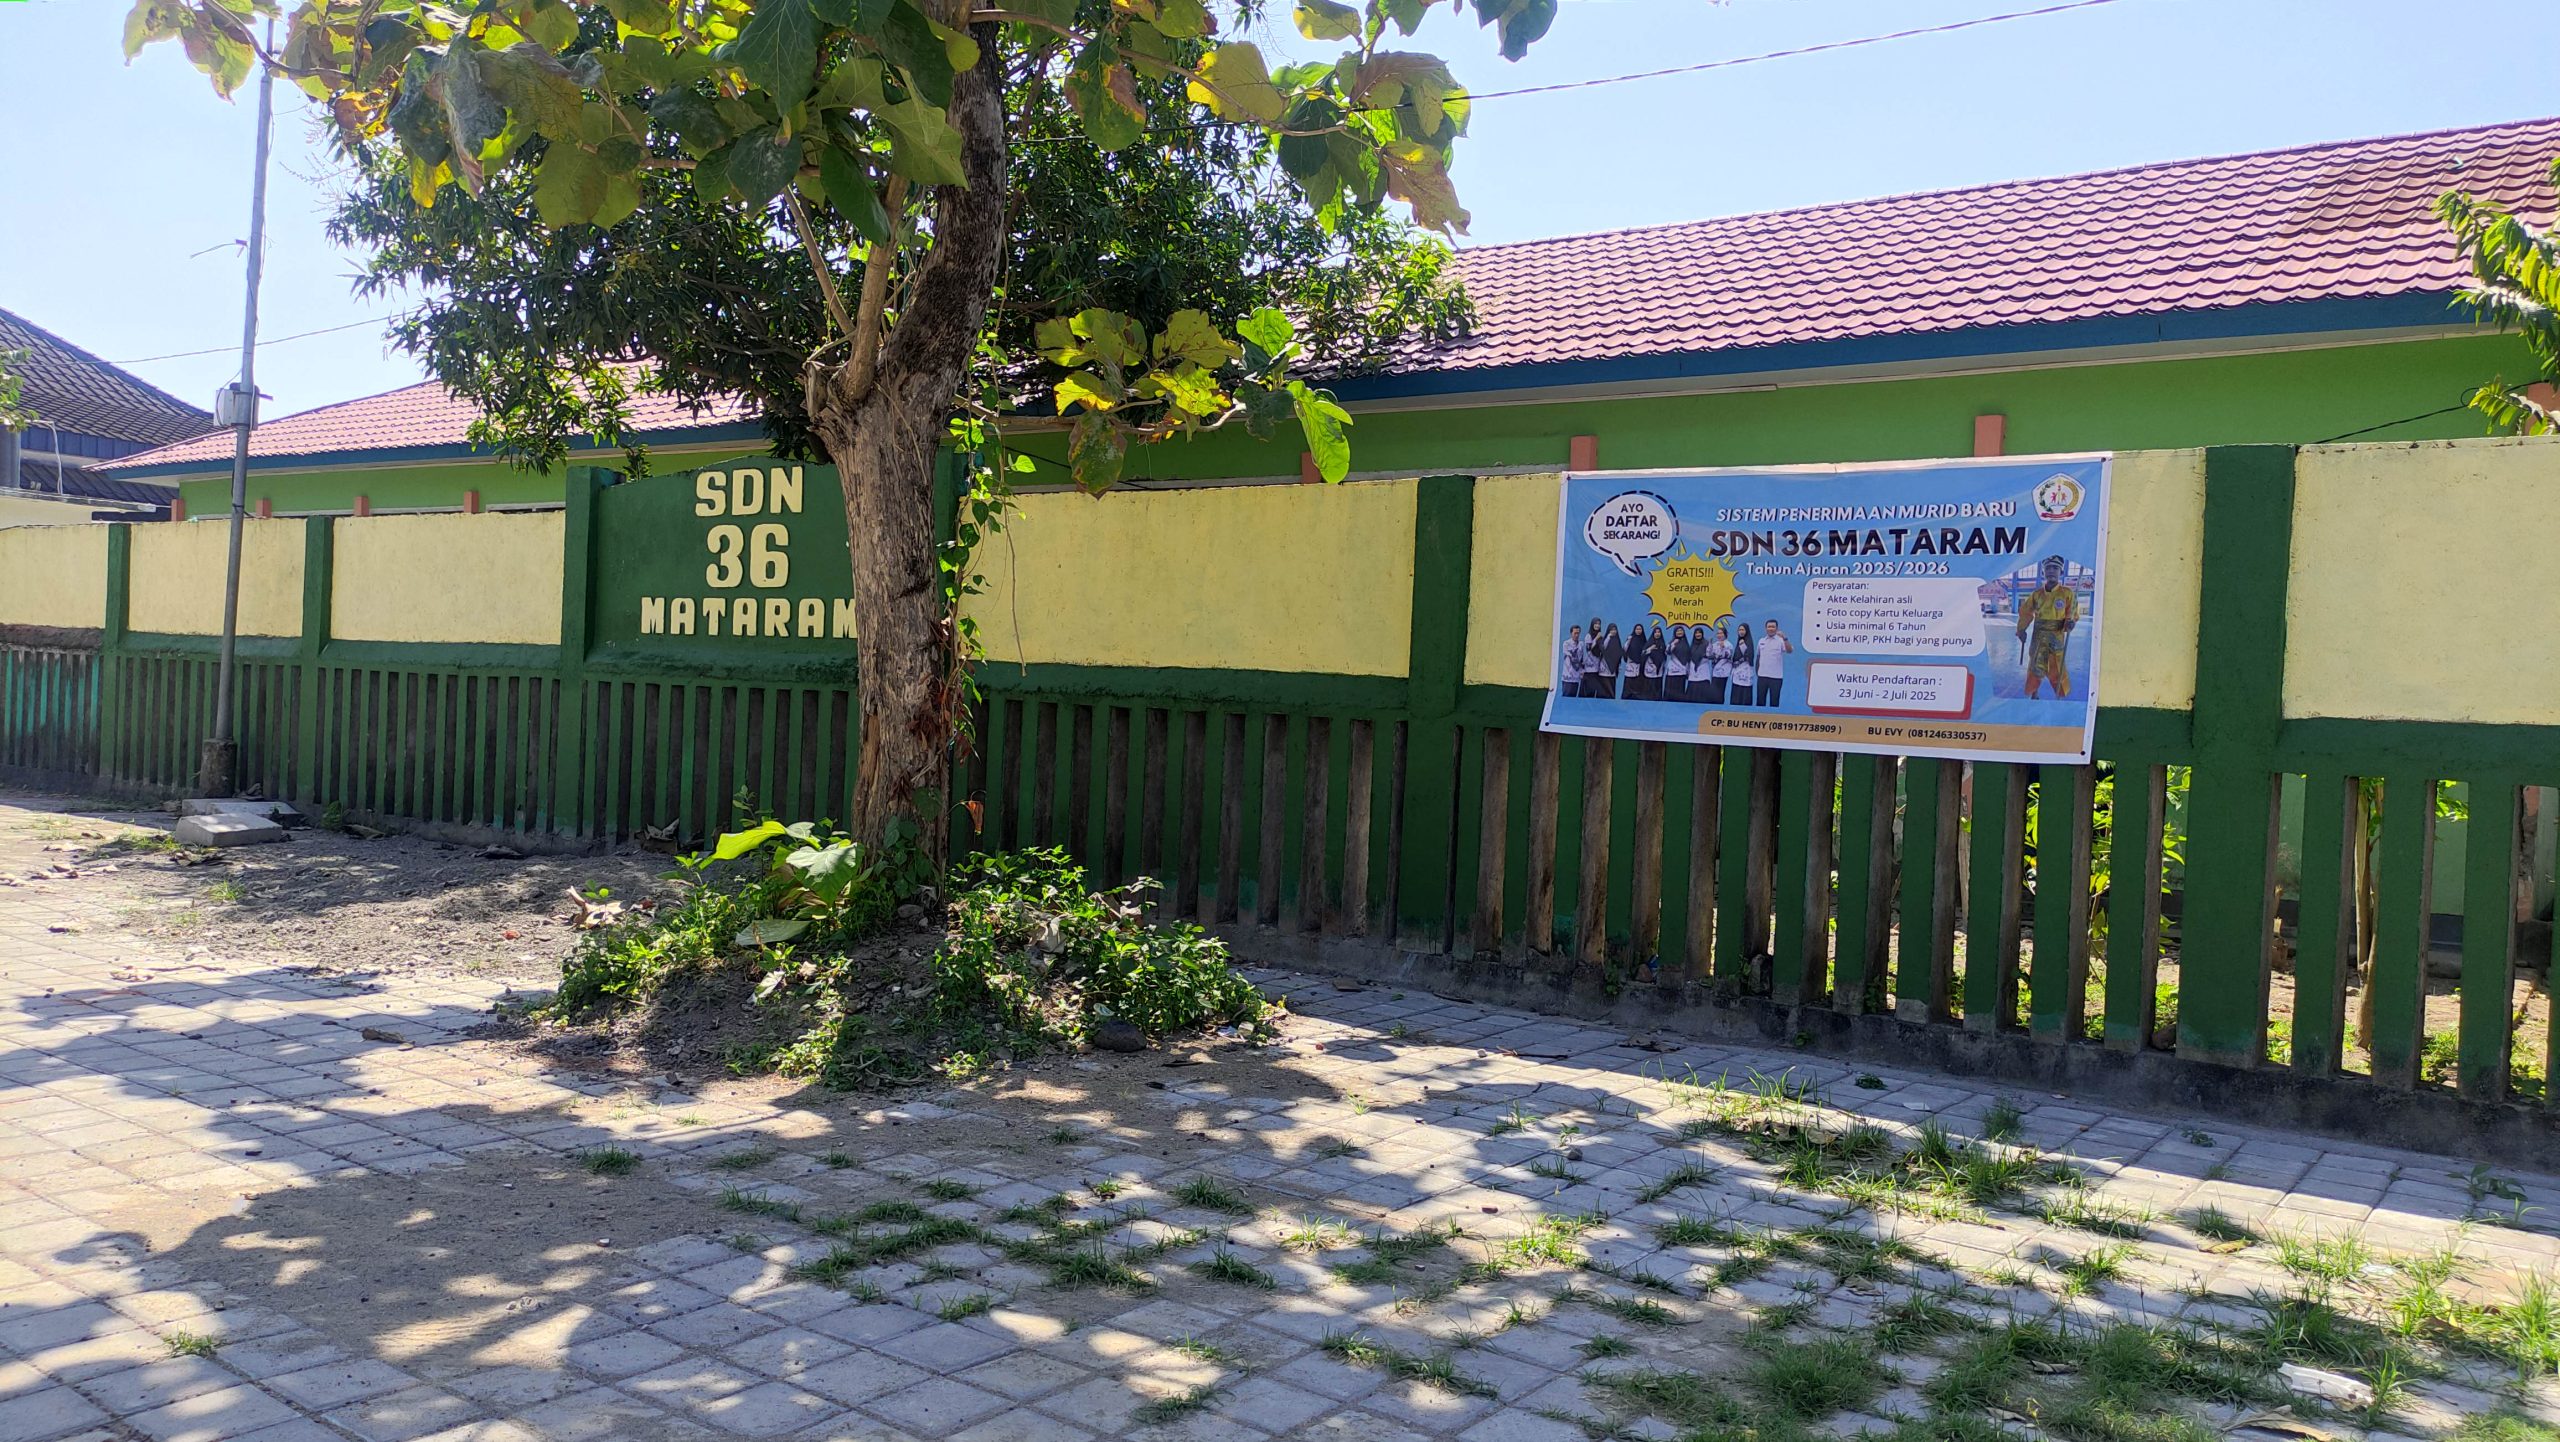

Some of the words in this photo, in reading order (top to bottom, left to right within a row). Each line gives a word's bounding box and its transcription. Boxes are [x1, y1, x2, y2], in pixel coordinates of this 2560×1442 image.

[695, 466, 803, 516] SDN
[1620, 503, 1644, 513] AYO
[1716, 508, 1778, 522] SISTEM
[1779, 505, 1897, 521] PENERIMAAN
[1898, 503, 1958, 519] MURID
[1961, 501, 2017, 518] BARU
[1605, 515, 1658, 528] DAFTAR
[1603, 530, 1661, 540] SEKARANG!
[1710, 530, 1776, 558] SDN
[1780, 529, 1824, 557] 36
[1828, 526, 2029, 557] MATARAM
[706, 523, 789, 588] 36
[1666, 567, 1714, 578] GRATIS!!!
[1746, 562, 1793, 575] Tahun
[1795, 562, 1850, 577] Ajaran
[1852, 560, 1950, 576] 2025/2026
[1669, 583, 1710, 595] Seragam
[1812, 581, 1870, 592] Persyaratan:
[1673, 597, 1704, 607] Merah
[1827, 595, 1848, 604] Akte
[1850, 595, 1895, 604] Kelahiran
[1896, 595, 1913, 604] asli
[641, 597, 858, 638] MATARAM
[1667, 612, 1691, 621] Putih
[1827, 608, 1848, 617] Foto
[1849, 611, 1872, 619] copy
[1874, 609, 1900, 618] Kartu
[1902, 609, 1944, 620] Keluarga
[1826, 622, 1846, 630] Usia
[1848, 622, 1886, 631] minimal
[1888, 622, 1895, 631] 6
[1898, 622, 1926, 631] Tahun
[1826, 635, 1851, 644] Kartu
[1853, 635, 1870, 645] KIP,
[1872, 636, 1892, 644] PKH
[1894, 635, 1914, 646] bagi
[1916, 638, 1940, 647] yang
[1942, 639, 1973, 647] punya
[1836, 673, 1869, 684] Waktu
[1871, 674, 1936, 686] Pendaftaran
[1839, 688, 1852, 698] 23
[1853, 689, 1874, 700] Juni
[1882, 690, 1889, 699] 2
[1890, 690, 1907, 701] Juli
[1910, 691, 1936, 701] 2025
[1711, 718, 1725, 727] CP:
[1727, 720, 1740, 728] BU
[1741, 720, 1767, 729] HENY
[1867, 726, 1882, 736] BU
[1884, 728, 1904, 737] EVY
[1908, 728, 1987, 743] (081246330537)
